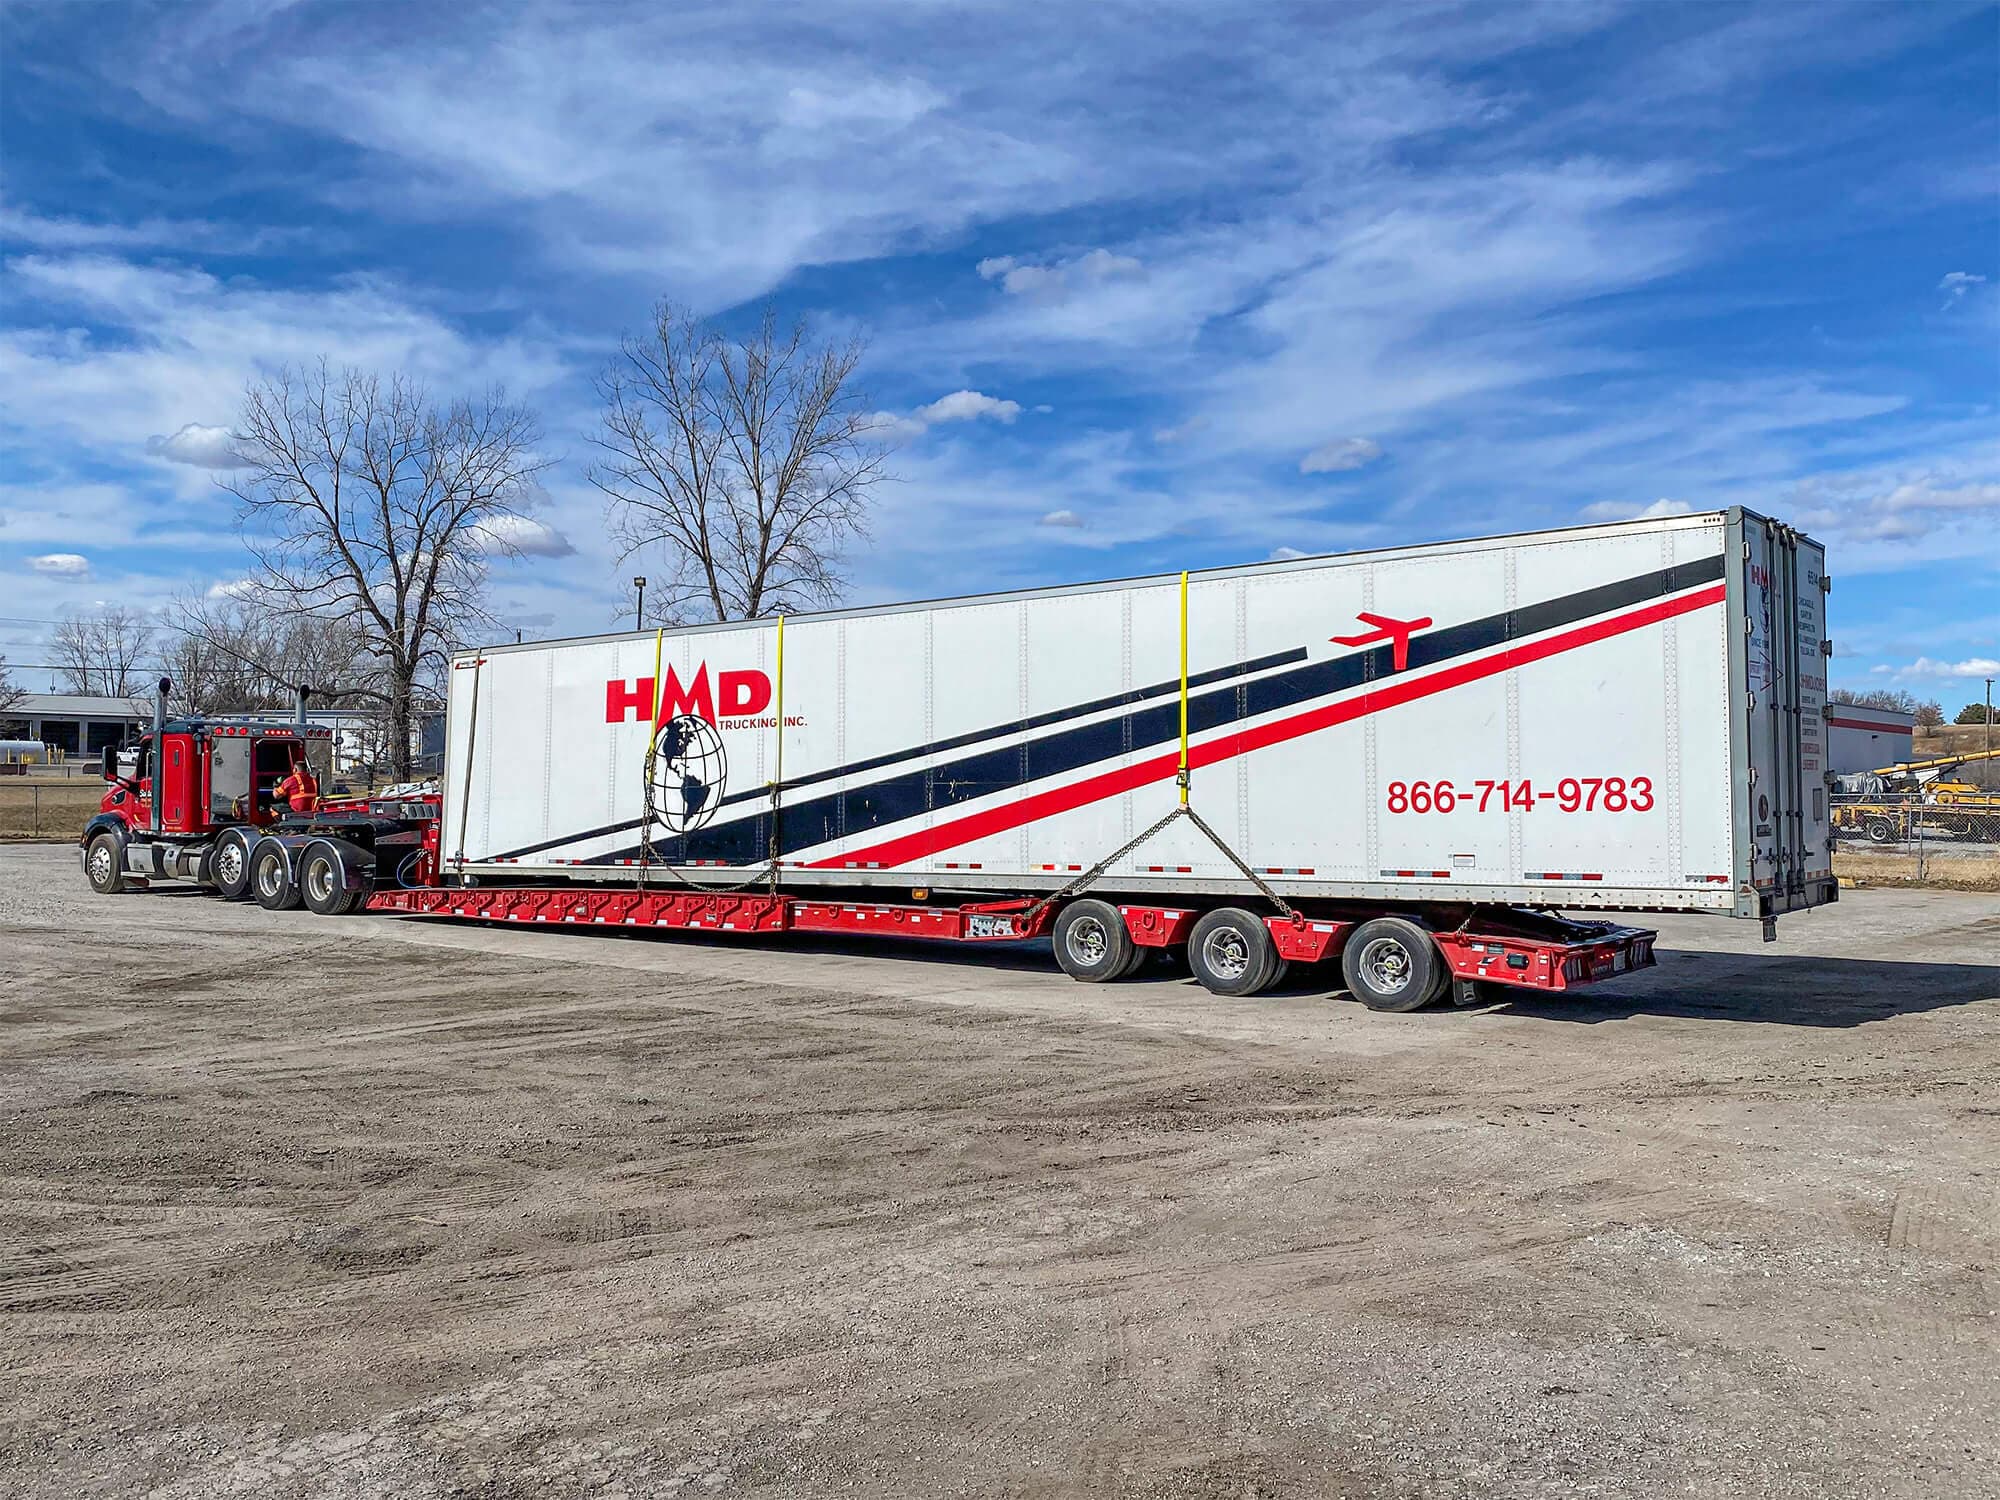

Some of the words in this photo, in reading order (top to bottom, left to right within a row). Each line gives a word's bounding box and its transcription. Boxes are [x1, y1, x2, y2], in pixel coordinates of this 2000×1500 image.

[605, 659, 772, 734] HMD
[719, 717, 778, 731] TRUCKING
[784, 716, 808, 728] INC.
[1387, 776, 1654, 814] 866-714-9783
